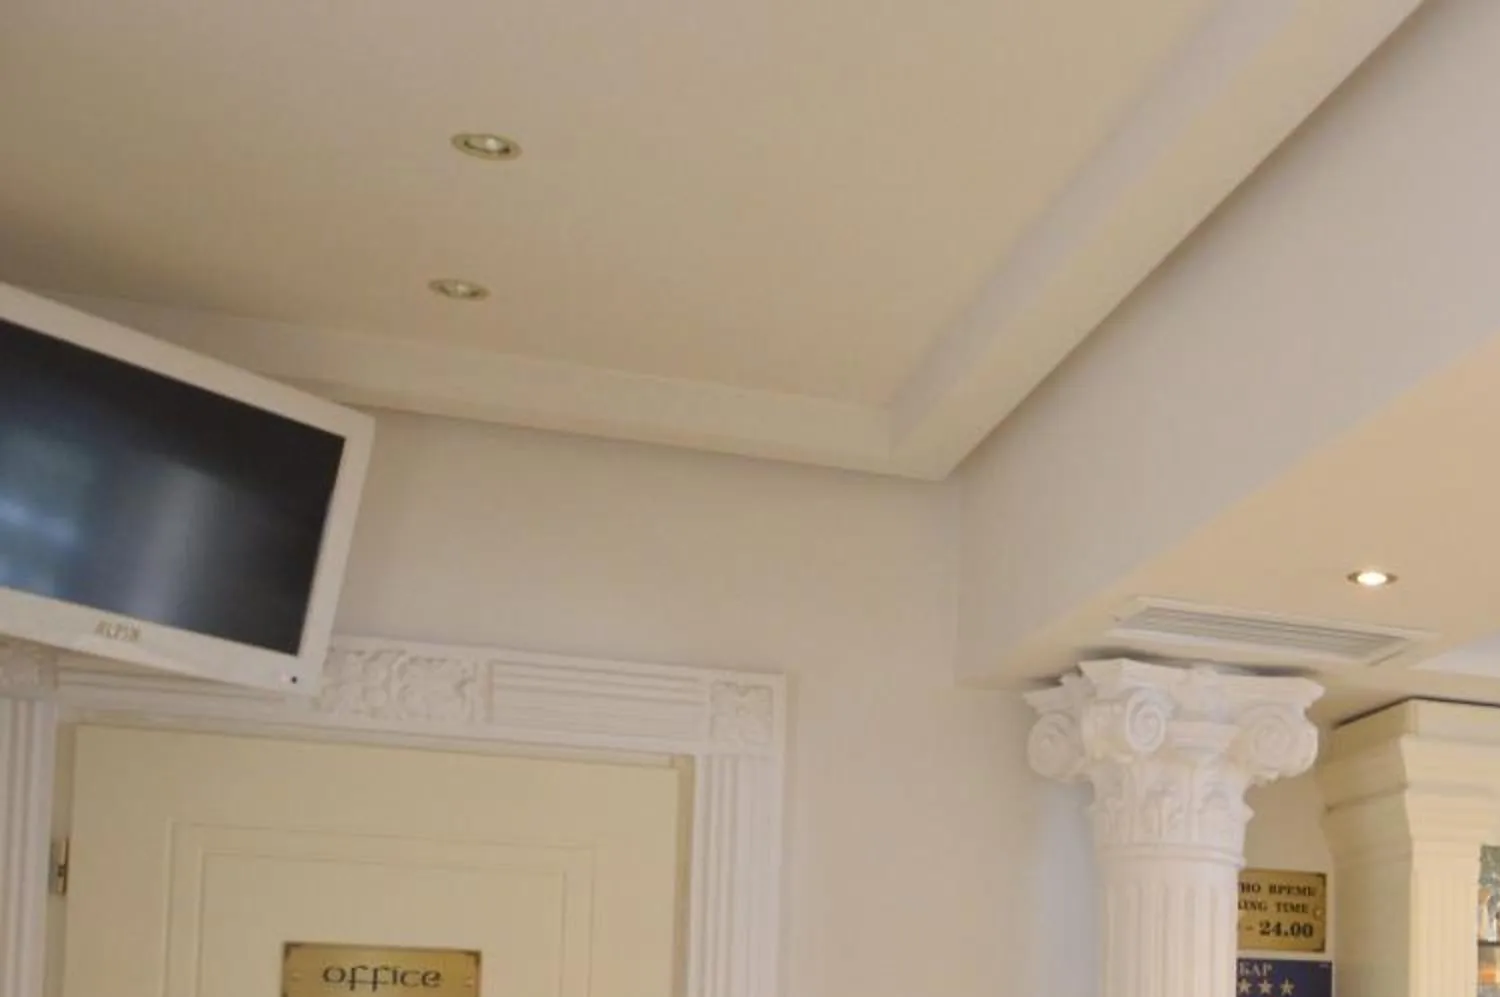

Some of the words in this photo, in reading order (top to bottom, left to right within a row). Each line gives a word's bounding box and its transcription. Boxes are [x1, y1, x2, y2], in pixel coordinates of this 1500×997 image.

[1238, 882, 1261, 894] НО
[1276, 902, 1309, 914] TIME
[1259, 921, 1314, 938] 24.00
[322, 965, 442, 992] office
